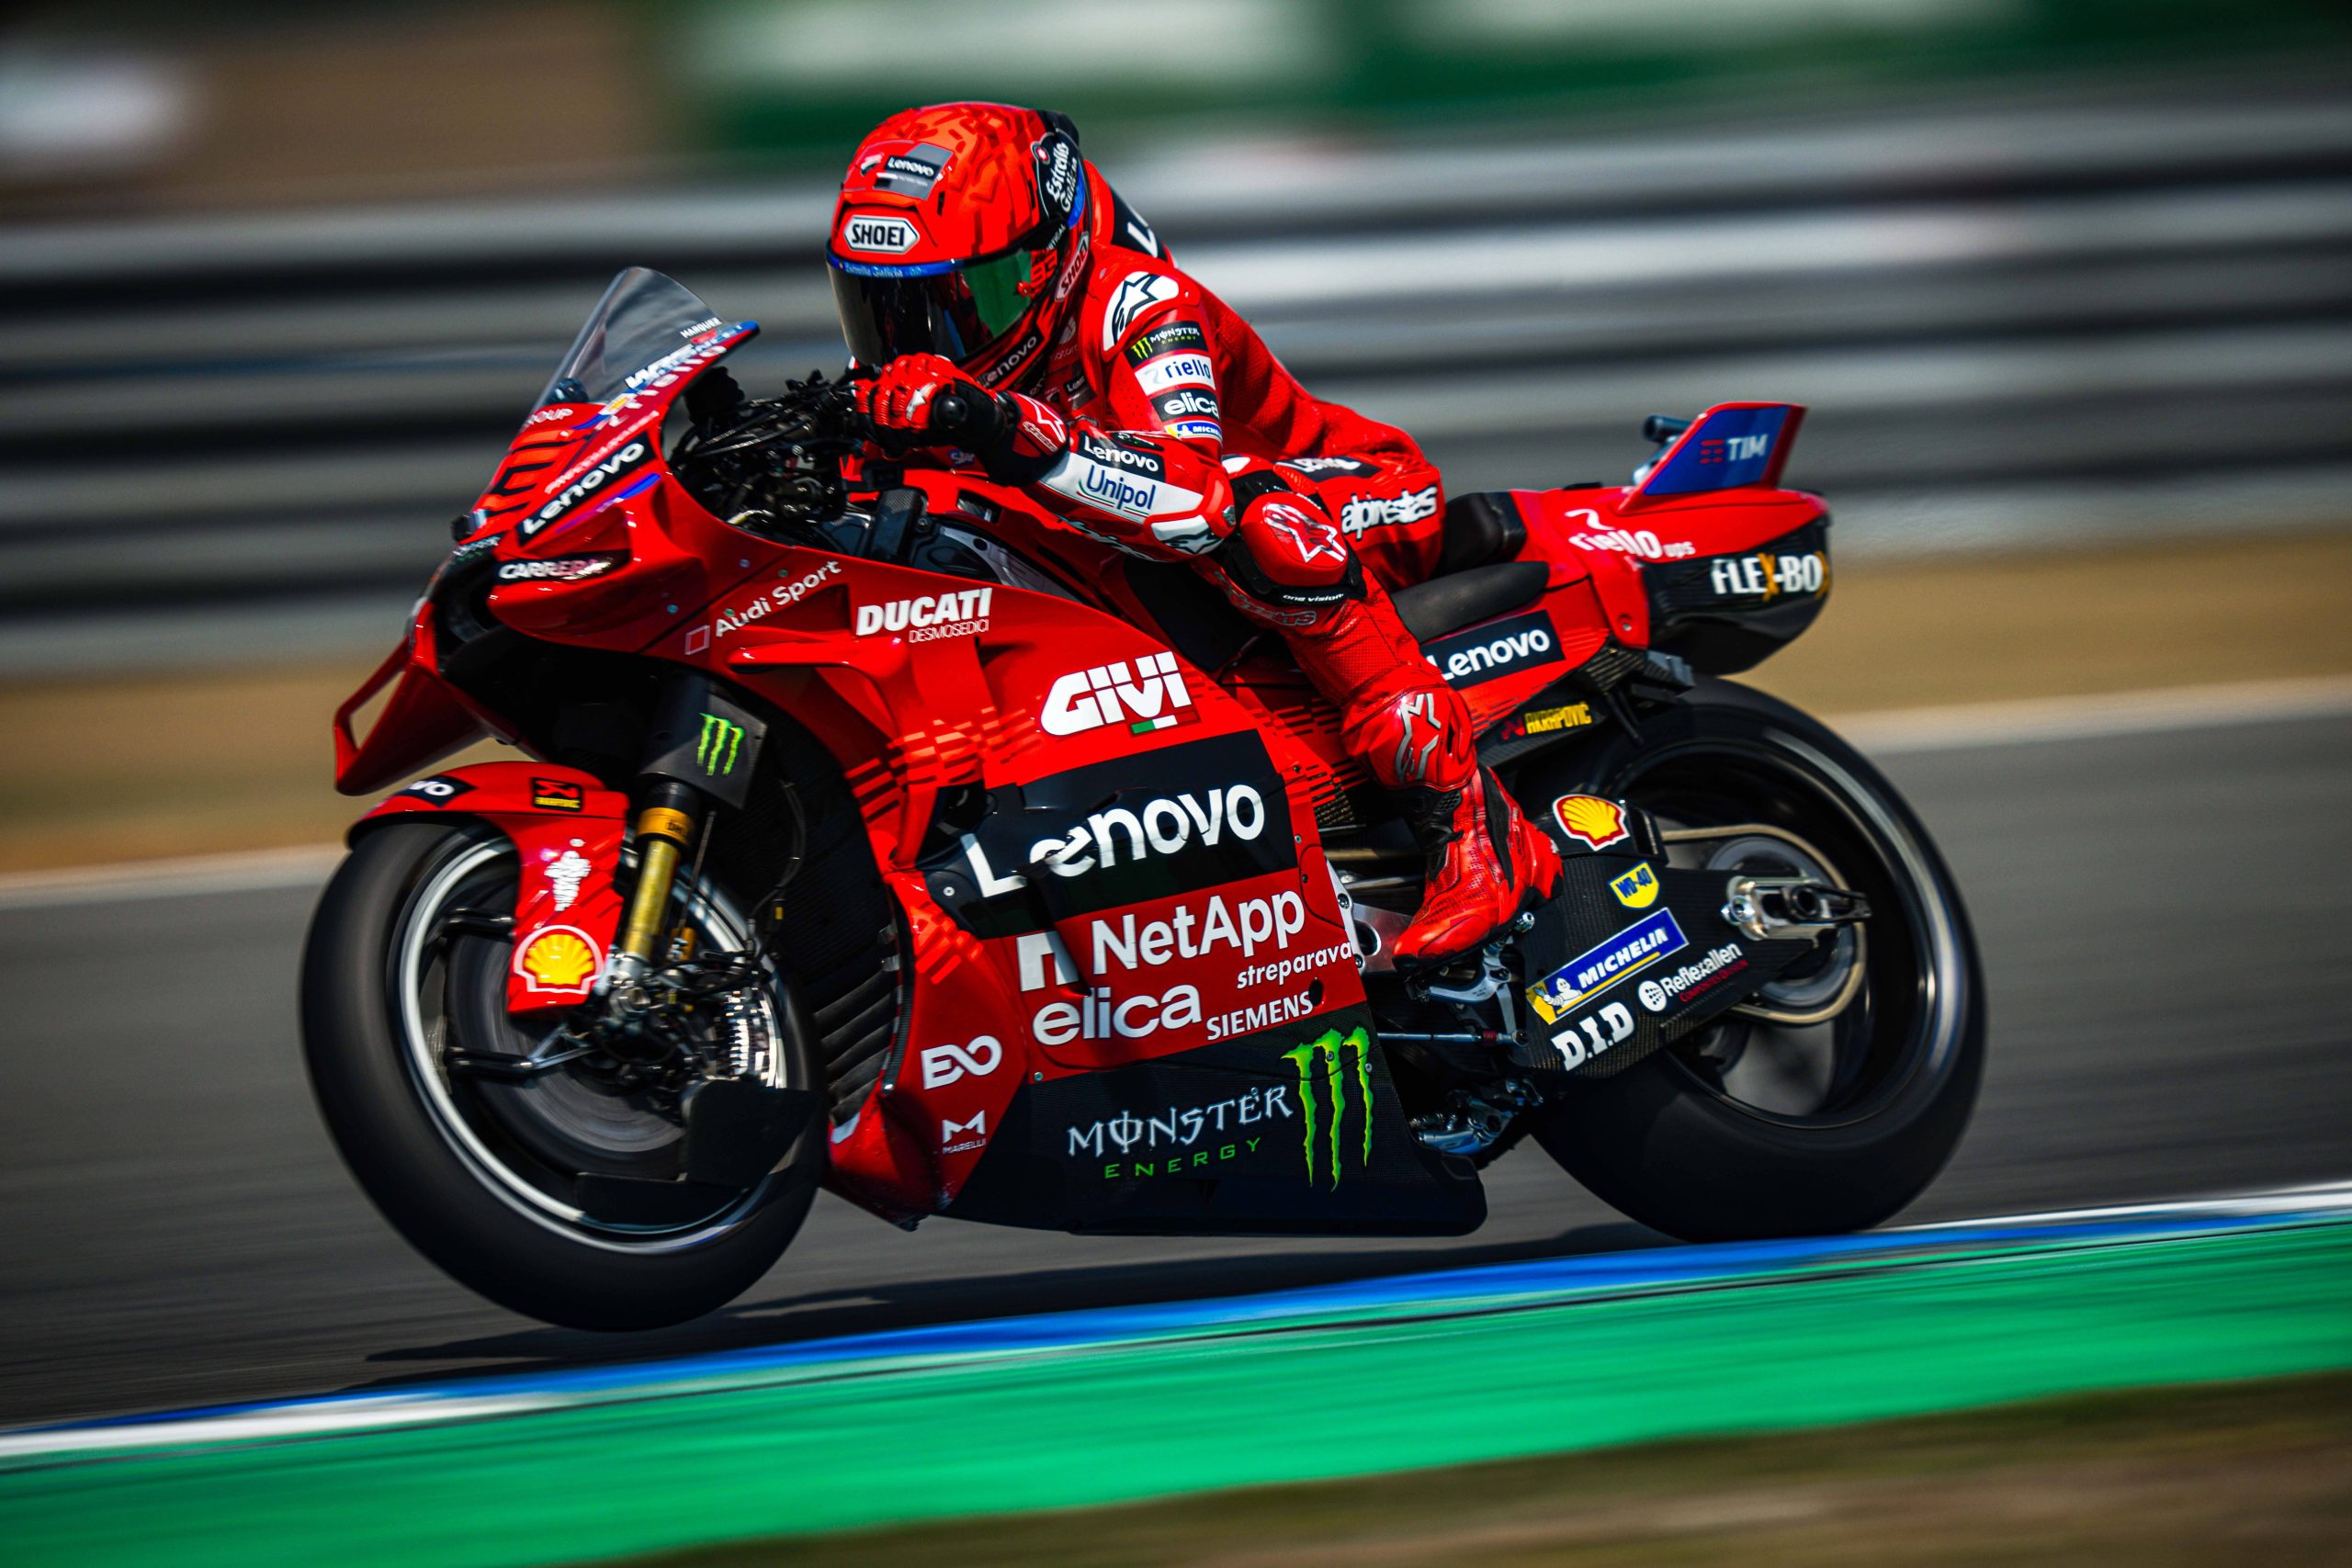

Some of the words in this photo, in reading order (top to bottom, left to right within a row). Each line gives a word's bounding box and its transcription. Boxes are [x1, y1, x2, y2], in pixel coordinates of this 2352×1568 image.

[888, 157, 934, 176] Lenovo
[852, 223, 905, 246] SHOEI
[1150, 327, 1200, 344] MONSTER
[1165, 359, 1212, 379] riello
[1164, 392, 1220, 420] elica
[1084, 435, 1159, 472] Lenovo
[1728, 434, 1769, 461] TIM
[524, 443, 644, 535] Lenovo
[1087, 465, 1156, 510] Unipol
[1568, 529, 1663, 559] riello
[716, 598, 772, 637] Audi
[772, 560, 842, 605] Sport
[855, 587, 992, 636] DUCATI
[1283, 594, 1306, 603] one
[1307, 592, 1342, 602] vision
[909, 619, 989, 643] DESMOSEDICI
[1425, 629, 1550, 681] Lenovo
[1040, 650, 1192, 736] GIVI
[960, 784, 1264, 897] Lenovo
[1615, 867, 1653, 898] WD-40
[1091, 889, 1306, 975] NetApp
[1237, 942, 1352, 989] streparava
[1577, 927, 1668, 989] MICHELIN
[1660, 943, 1743, 998] Reflexallen
[1033, 984, 1202, 1045] elica
[1206, 991, 1314, 1041] SIEMENS
[1551, 1002, 1634, 1071] D.I.D
[1067, 1084, 1294, 1157] MONSTER
[1105, 1137, 1261, 1179] ENERGY
